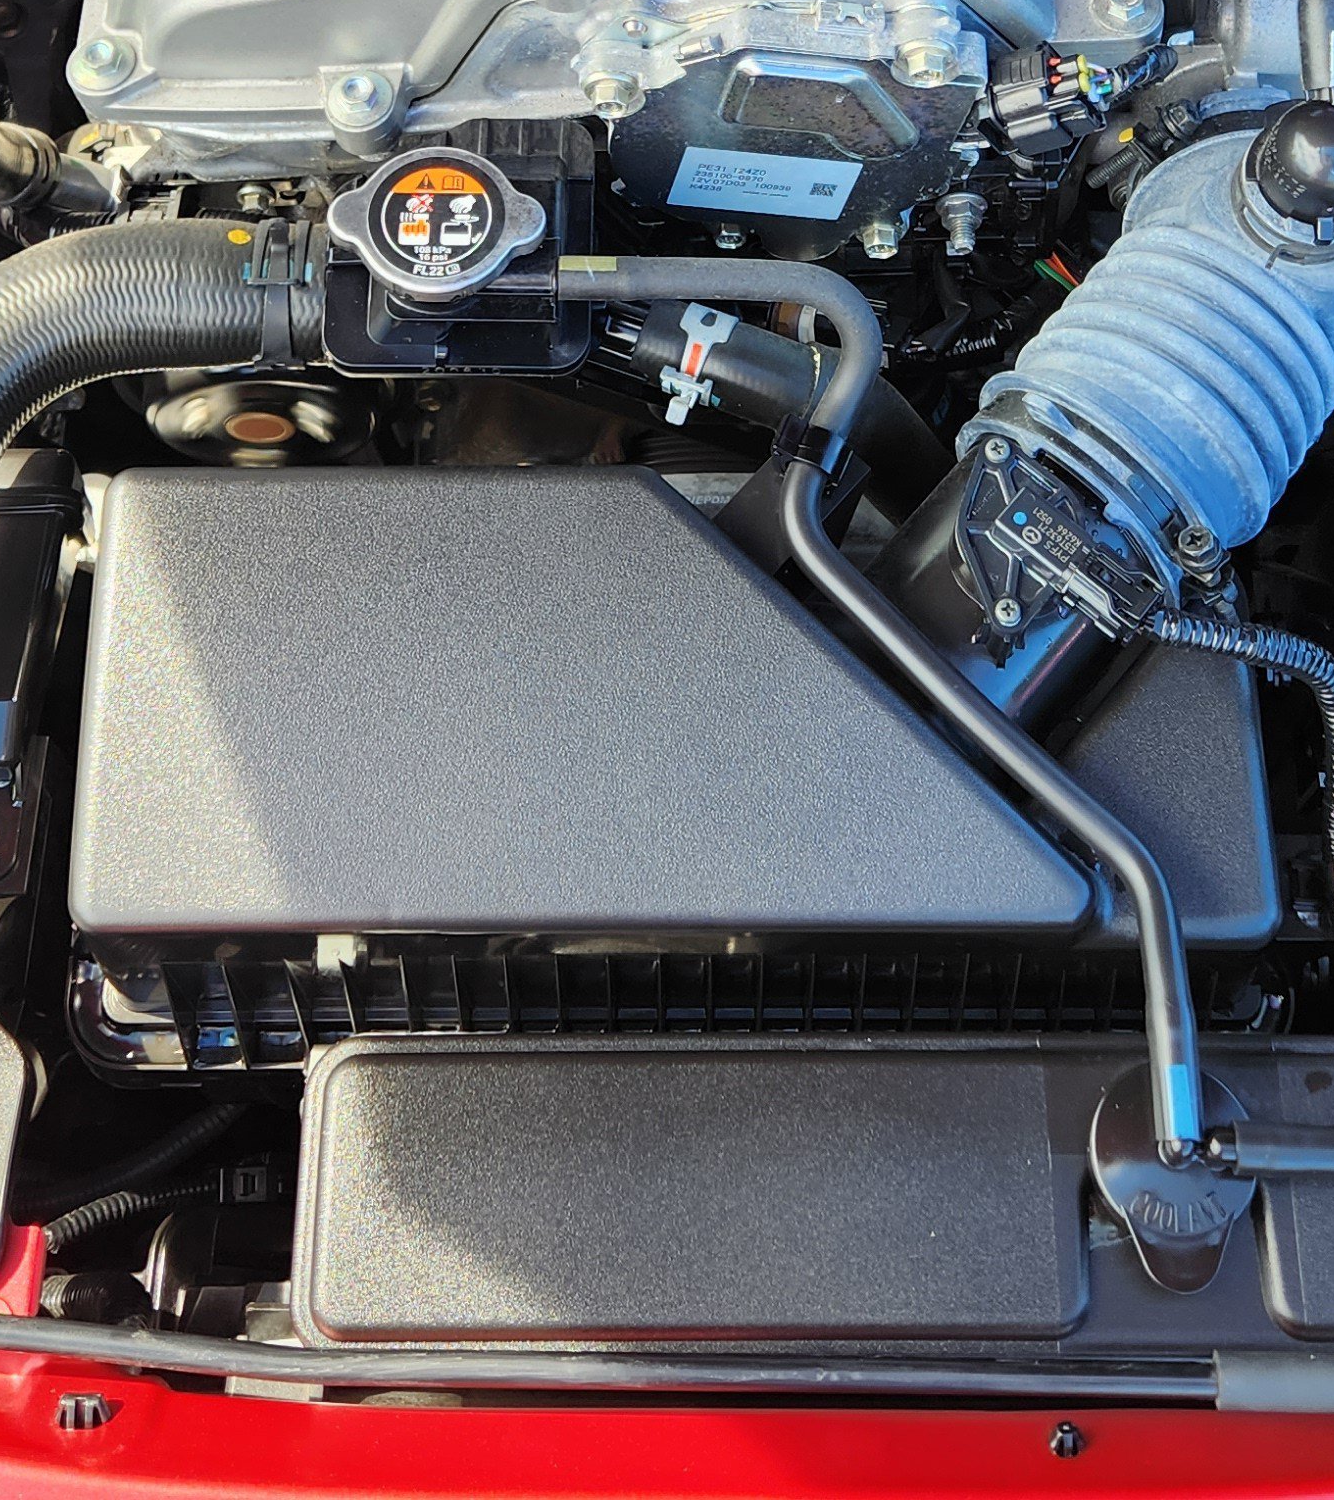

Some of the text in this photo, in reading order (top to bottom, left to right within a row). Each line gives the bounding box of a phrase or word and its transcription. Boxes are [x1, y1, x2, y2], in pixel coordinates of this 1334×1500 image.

[432, 246, 452, 255] kPa
[432, 254, 448, 263] psi
[413, 264, 445, 276] FL22
[1032, 506, 1053, 525] 0521
[1043, 540, 1071, 563] PYFS
[1129, 1190, 1227, 1235] COOLANT
